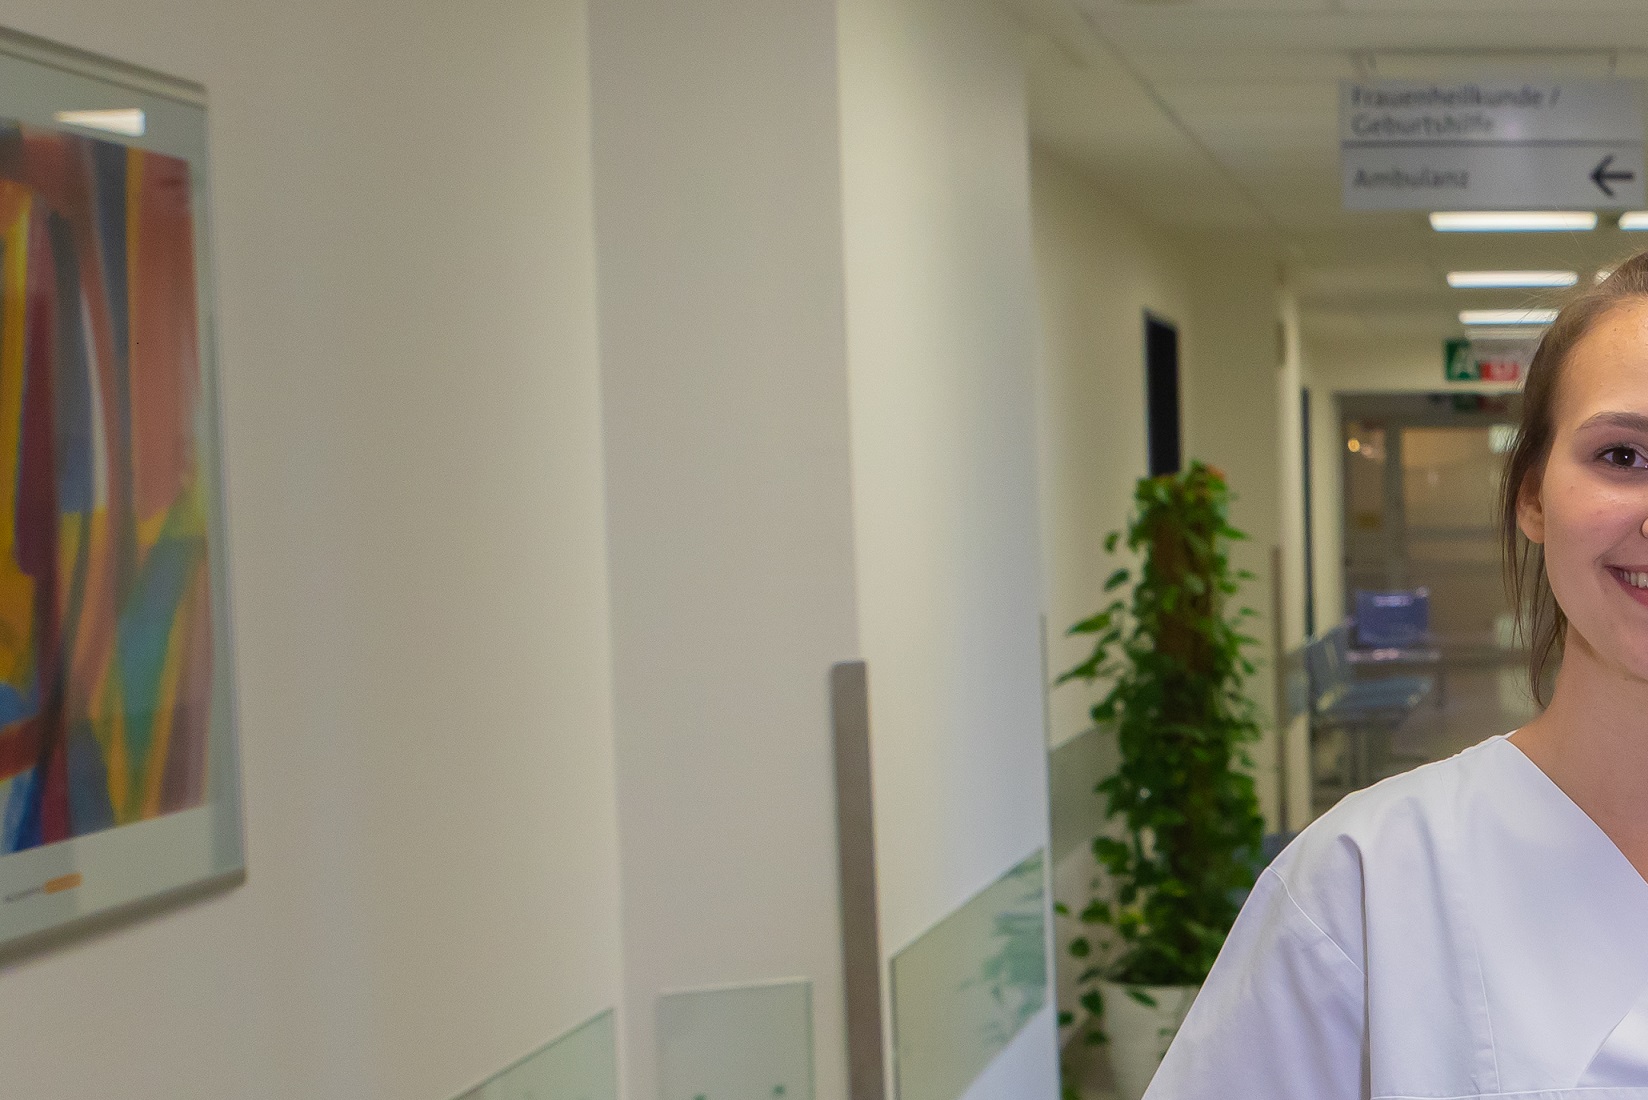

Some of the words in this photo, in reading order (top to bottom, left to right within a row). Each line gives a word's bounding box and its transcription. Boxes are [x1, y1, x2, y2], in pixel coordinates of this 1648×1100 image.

[1351, 85, 1544, 107] Frauenheilkunde
[1351, 113, 1494, 136] Geburtshilfe
[1353, 169, 1470, 190] Ambulanz
